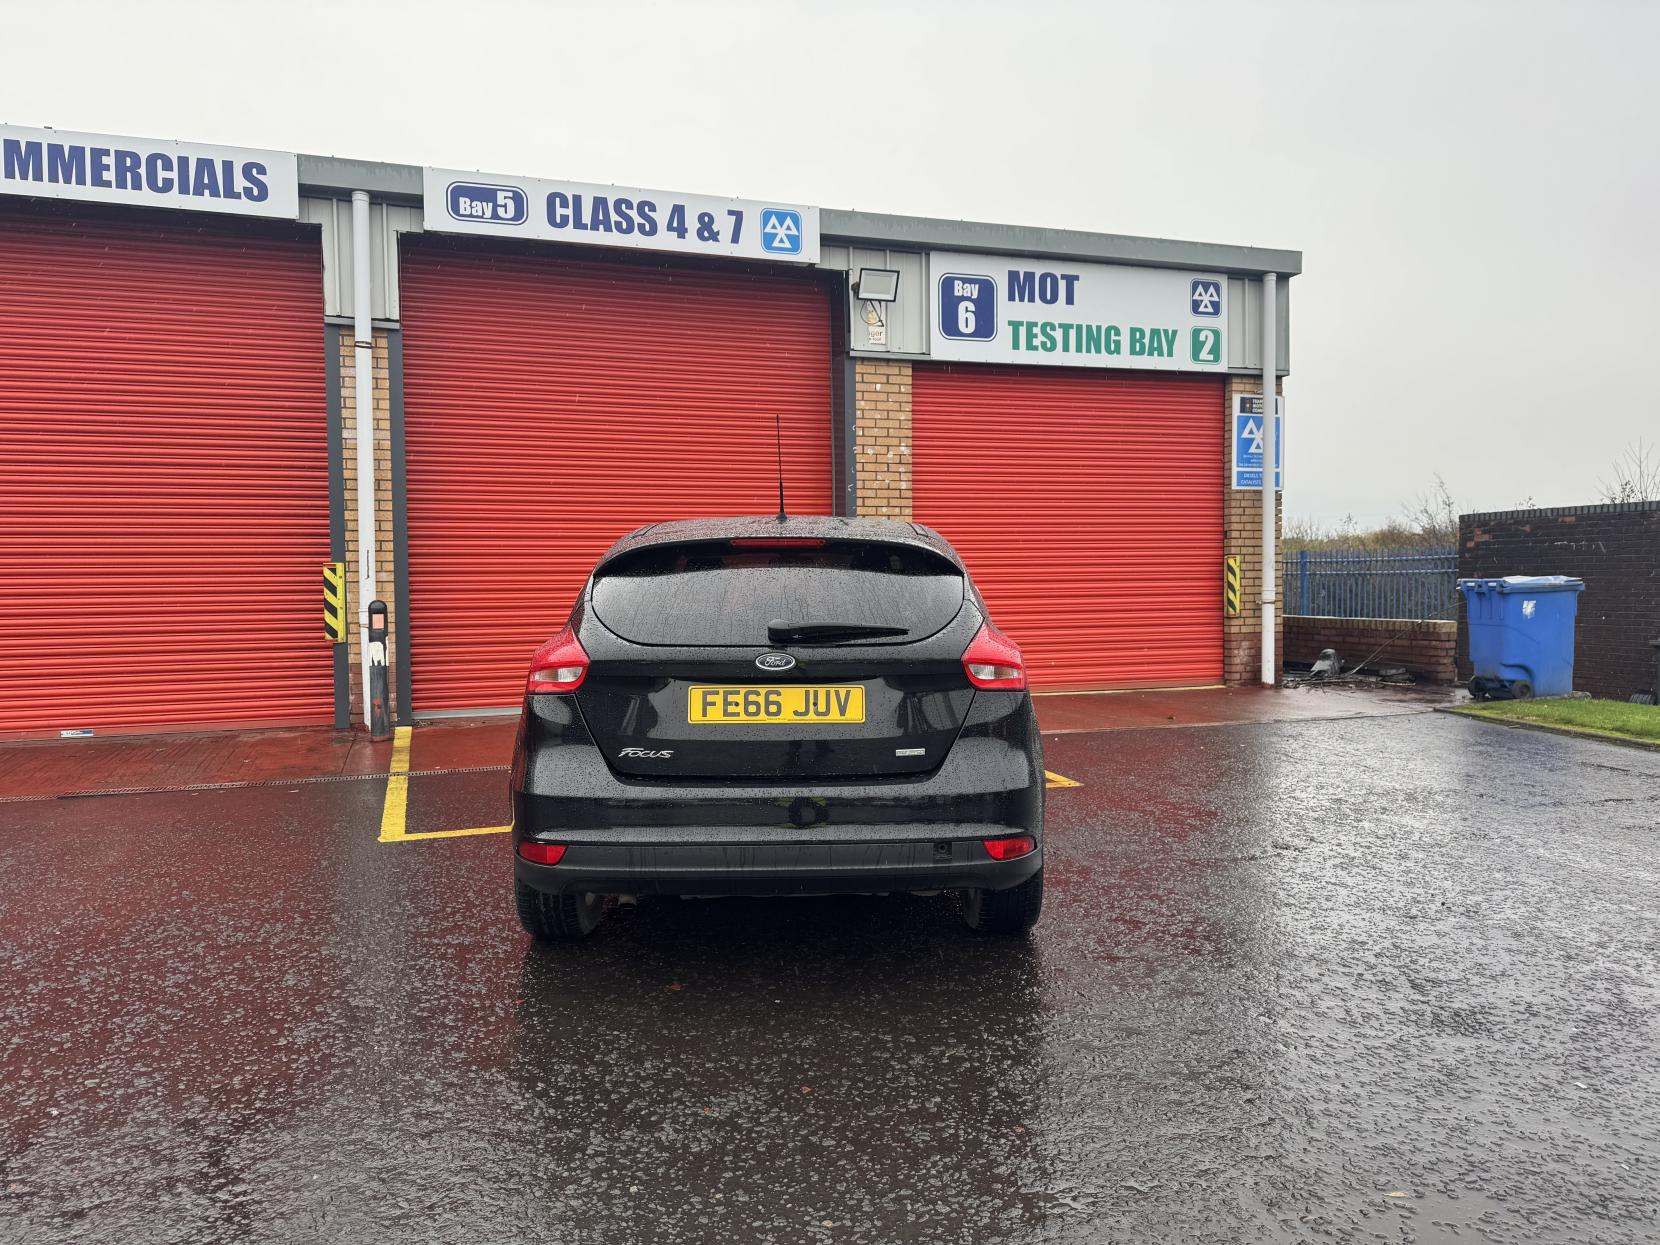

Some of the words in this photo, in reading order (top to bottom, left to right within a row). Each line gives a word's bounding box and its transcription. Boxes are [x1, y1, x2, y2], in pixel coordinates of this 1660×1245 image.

[3, 138, 269, 202] MMERCIALS
[459, 196, 493, 219] Bay
[496, 190, 515, 219] 5
[546, 191, 658, 237] CLASS
[666, 204, 689, 239] 4
[696, 212, 721, 242] &
[727, 209, 744, 244] 7
[953, 280, 979, 300] Bay
[1008, 270, 1080, 305] MOT
[957, 301, 976, 334] 6
[1008, 320, 1121, 356] TESTING
[1129, 326, 1178, 358] BAY
[1198, 330, 1214, 360] 2
[702, 690, 782, 717] FE66
[793, 689, 852, 717] JUV
